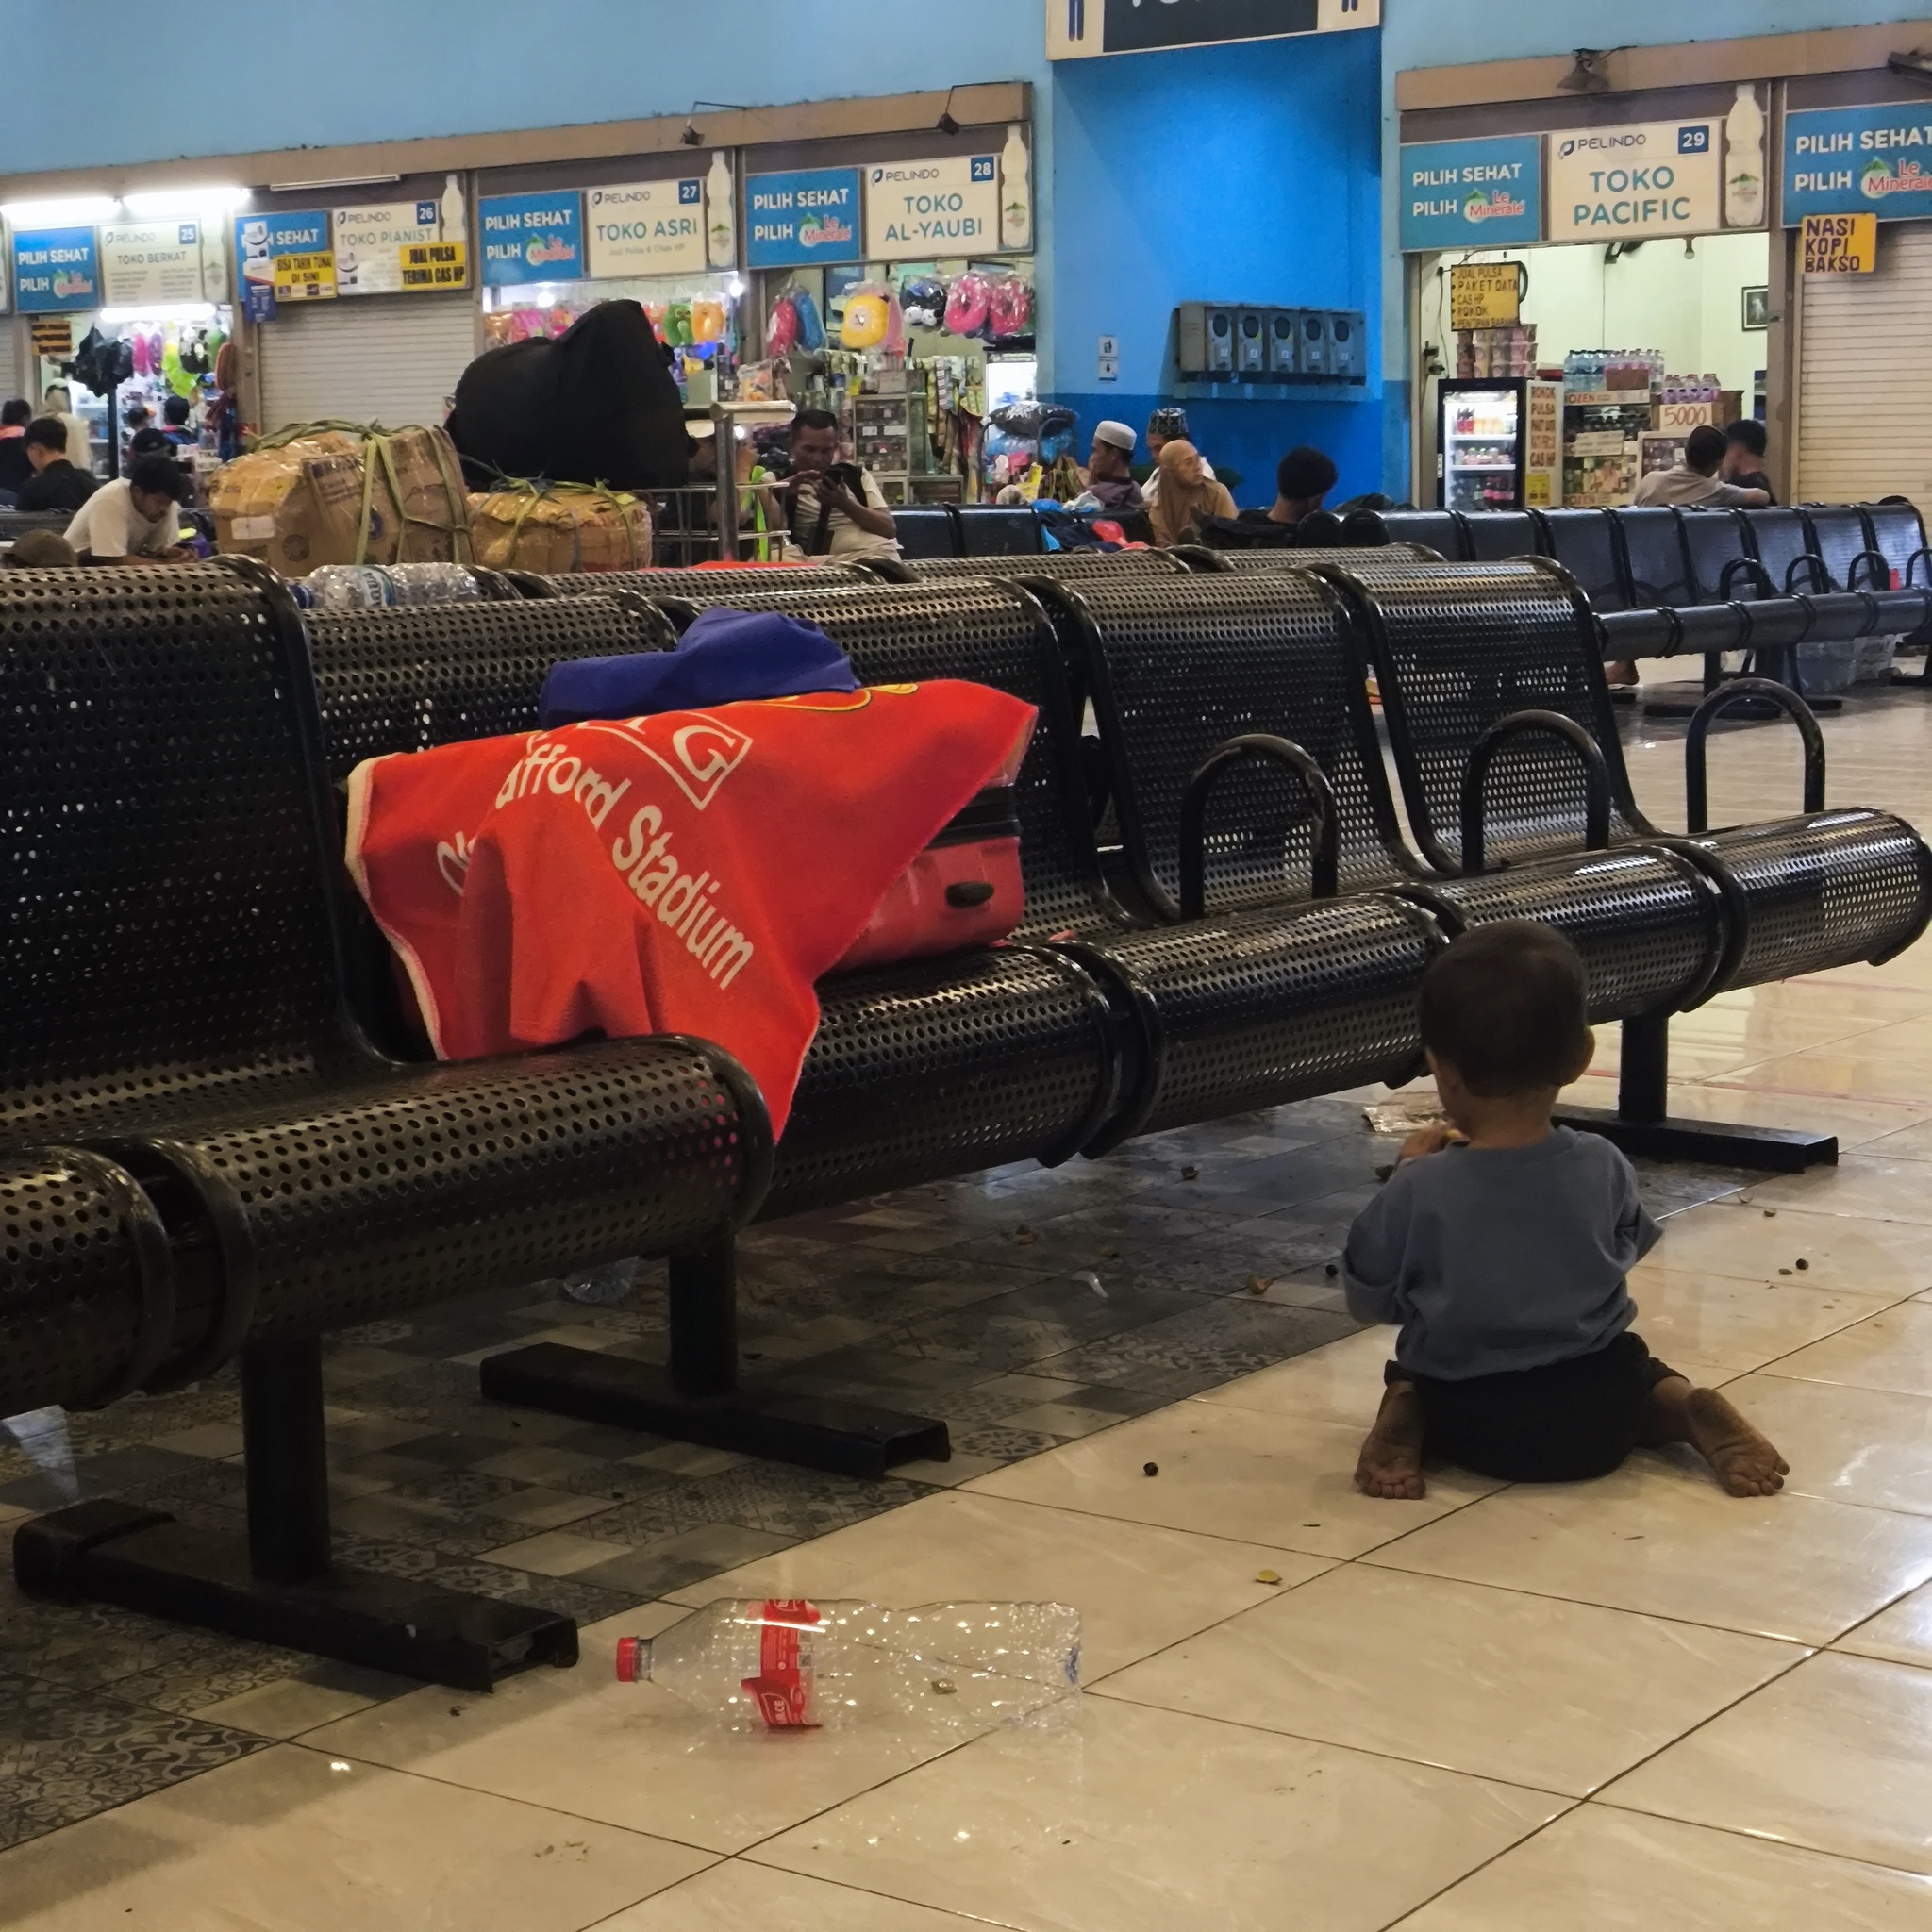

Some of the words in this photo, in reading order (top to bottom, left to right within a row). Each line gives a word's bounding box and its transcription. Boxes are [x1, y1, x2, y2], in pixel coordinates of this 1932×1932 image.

[1578, 134, 1646, 150] PELINDO
[1682, 132, 1705, 147] 29
[1796, 132, 1853, 154] PILIH
[1859, 126, 1932, 150] SEHAT
[886, 169, 939, 181] PELINDO
[974, 163, 991, 176] 28
[1413, 169, 1457, 187] PILIH
[1462, 163, 1522, 182] SEHAT
[1899, 159, 1919, 175] Le
[1589, 166, 1674, 192] TOKO
[1795, 170, 1852, 192] PILIH
[604, 191, 651, 204] PELINDO
[682, 186, 697, 198] 27
[754, 192, 792, 209] PILIH
[797, 188, 848, 207] SEHAT
[1493, 191, 1508, 204] Le
[903, 193, 963, 214] TOKO
[1413, 200, 1457, 217] PILIH
[1470, 202, 1524, 217] Minerale
[1574, 197, 1690, 226] PACIFIC
[348, 212, 391, 224] PELINDO
[420, 208, 433, 219] 26
[486, 214, 520, 230] PILIH
[524, 210, 571, 227] SEHAT
[824, 216, 838, 227] Le
[181, 228, 195, 241] 25
[596, 222, 646, 241] TOKO
[654, 218, 697, 237] ASRI
[755, 224, 792, 241] PILIH
[804, 226, 851, 241] Minerale
[885, 218, 982, 242] AL-YAUBI
[1806, 218, 1855, 236] NASI
[115, 233, 155, 243] PELINDO
[276, 228, 319, 245] SEHAT
[341, 233, 375, 246] TOKO
[380, 228, 432, 243] PIANIST
[487, 243, 521, 259] PILIH
[1805, 237, 1849, 256] KOPI
[18, 250, 47, 264] PILIH
[50, 248, 89, 262] SEHAT
[117, 254, 144, 264] TOKO
[147, 251, 186, 263] BERKAT
[1478, 267, 1502, 278] PULSA
[1805, 256, 1860, 273] BAKSO
[435, 267, 451, 282] CAS
[20, 277, 49, 291] PILIH
[1458, 280, 1492, 291] PAKET
[1495, 279, 1517, 291] DATA
[1457, 294, 1472, 305] CAS
[1457, 306, 1489, 317] ROKOK
[1665, 406, 1707, 426] 5000
[613, 805, 754, 990] Stadium
